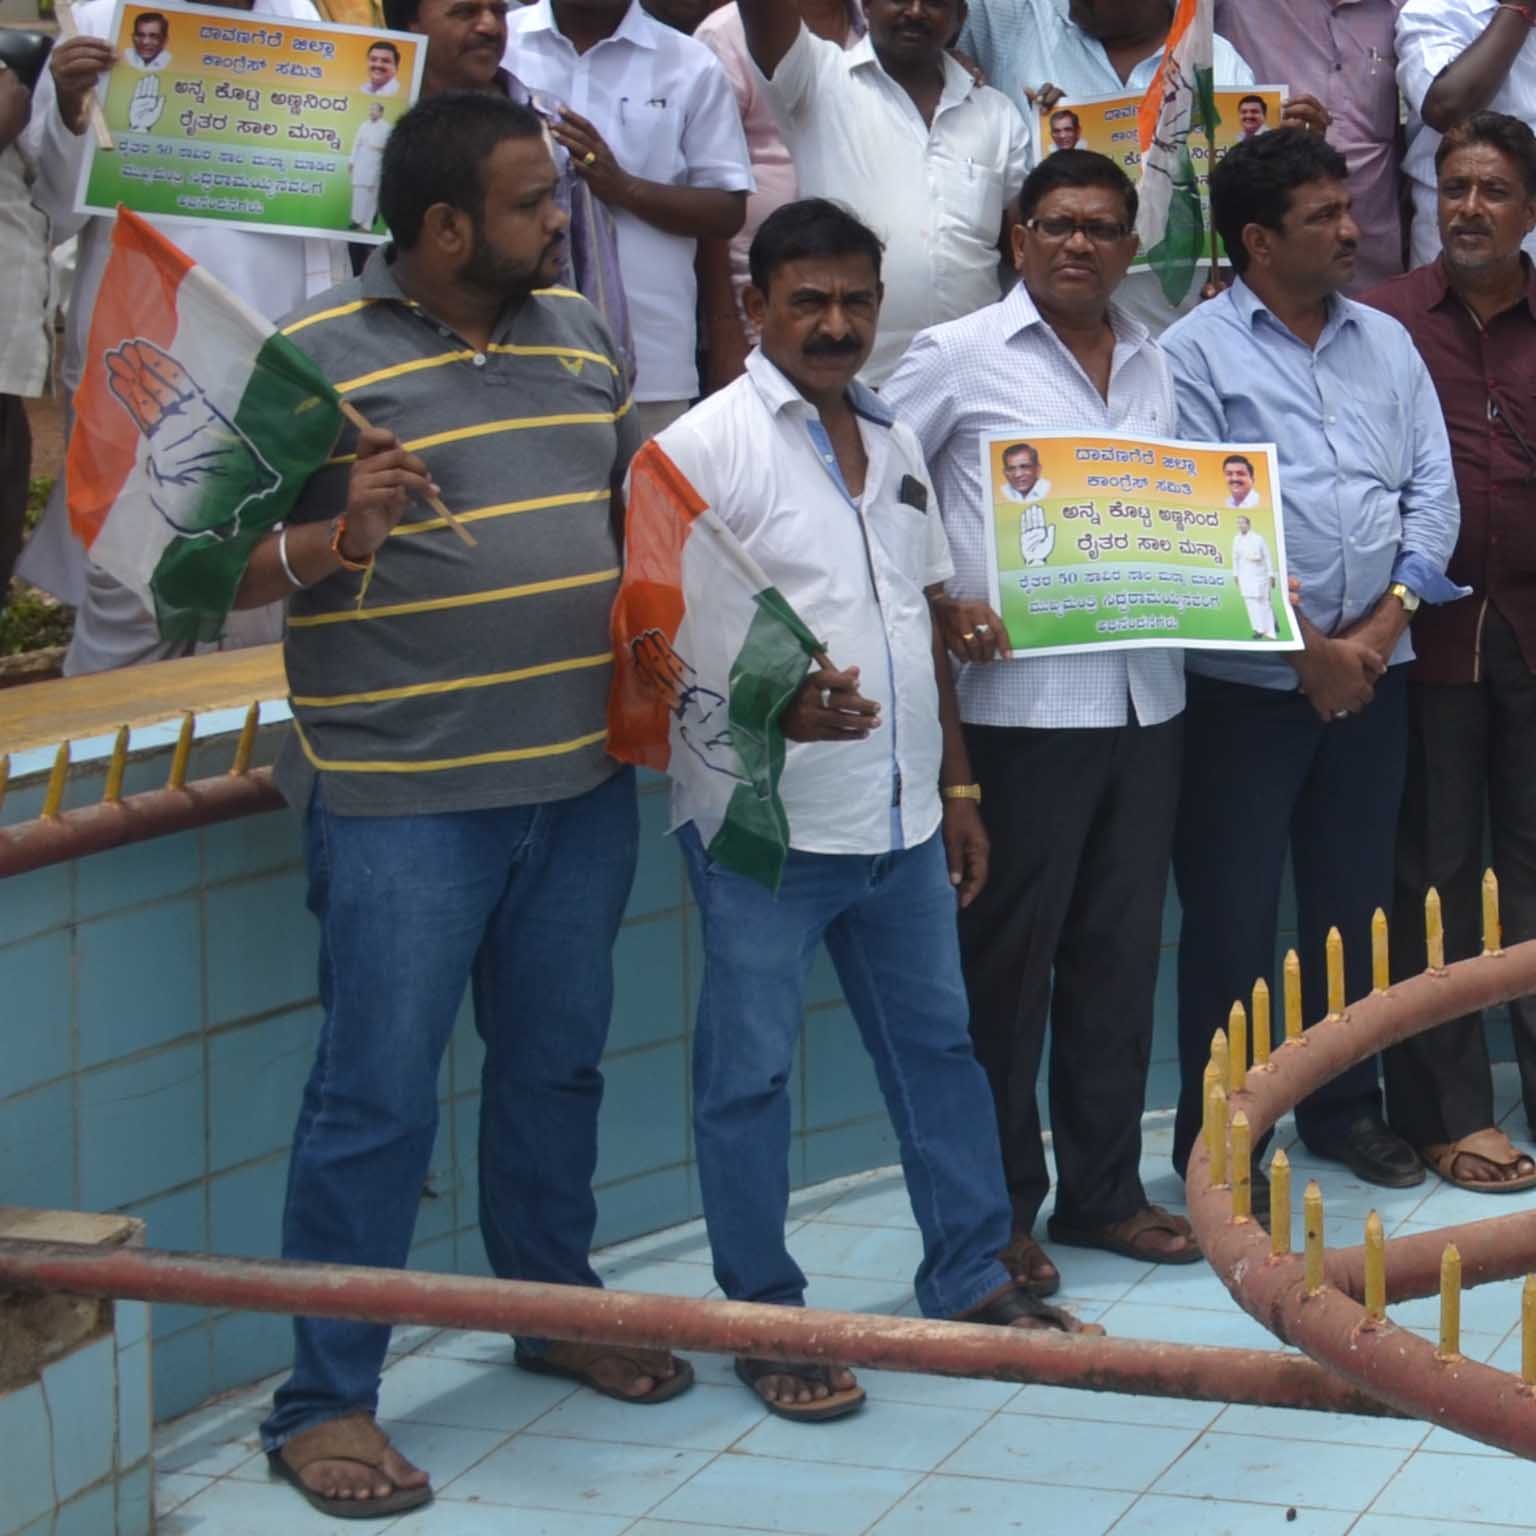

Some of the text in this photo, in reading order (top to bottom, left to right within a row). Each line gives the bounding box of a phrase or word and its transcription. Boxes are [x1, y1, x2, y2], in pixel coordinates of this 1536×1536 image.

[200, 25, 336, 59] ದಾವಣಗೆರೆ ಜಿಲ್ಲಾ
[203, 52, 323, 78] ಕಾಂಗ್ರೆಸ್ ಸಮಿತಿ
[175, 79, 348, 115] ಅನ್ನ ಕೊಟ್ಟ ಅಣ್ಣನಿಂದ
[180, 112, 341, 149] ರೈತರ ಸಾಲ ಮನ್ನಾ
[1075, 447, 1197, 475] ದಾವಣಗೆರೆ ಜಿಲ್ಲಾ
[1087, 474, 1192, 495] ಕಾಂಗ್ರೆಸ್ ಸಮಿತಿ
[1062, 502, 1219, 531] ಅನ್ನ ಕೊಟ್ಟ ಅಣ್ಣನಿಂದ
[1078, 534, 1223, 563] ರೈತರ ಸಾಲ ಮನ್ನಾ
[1058, 572, 1078, 585] 50
